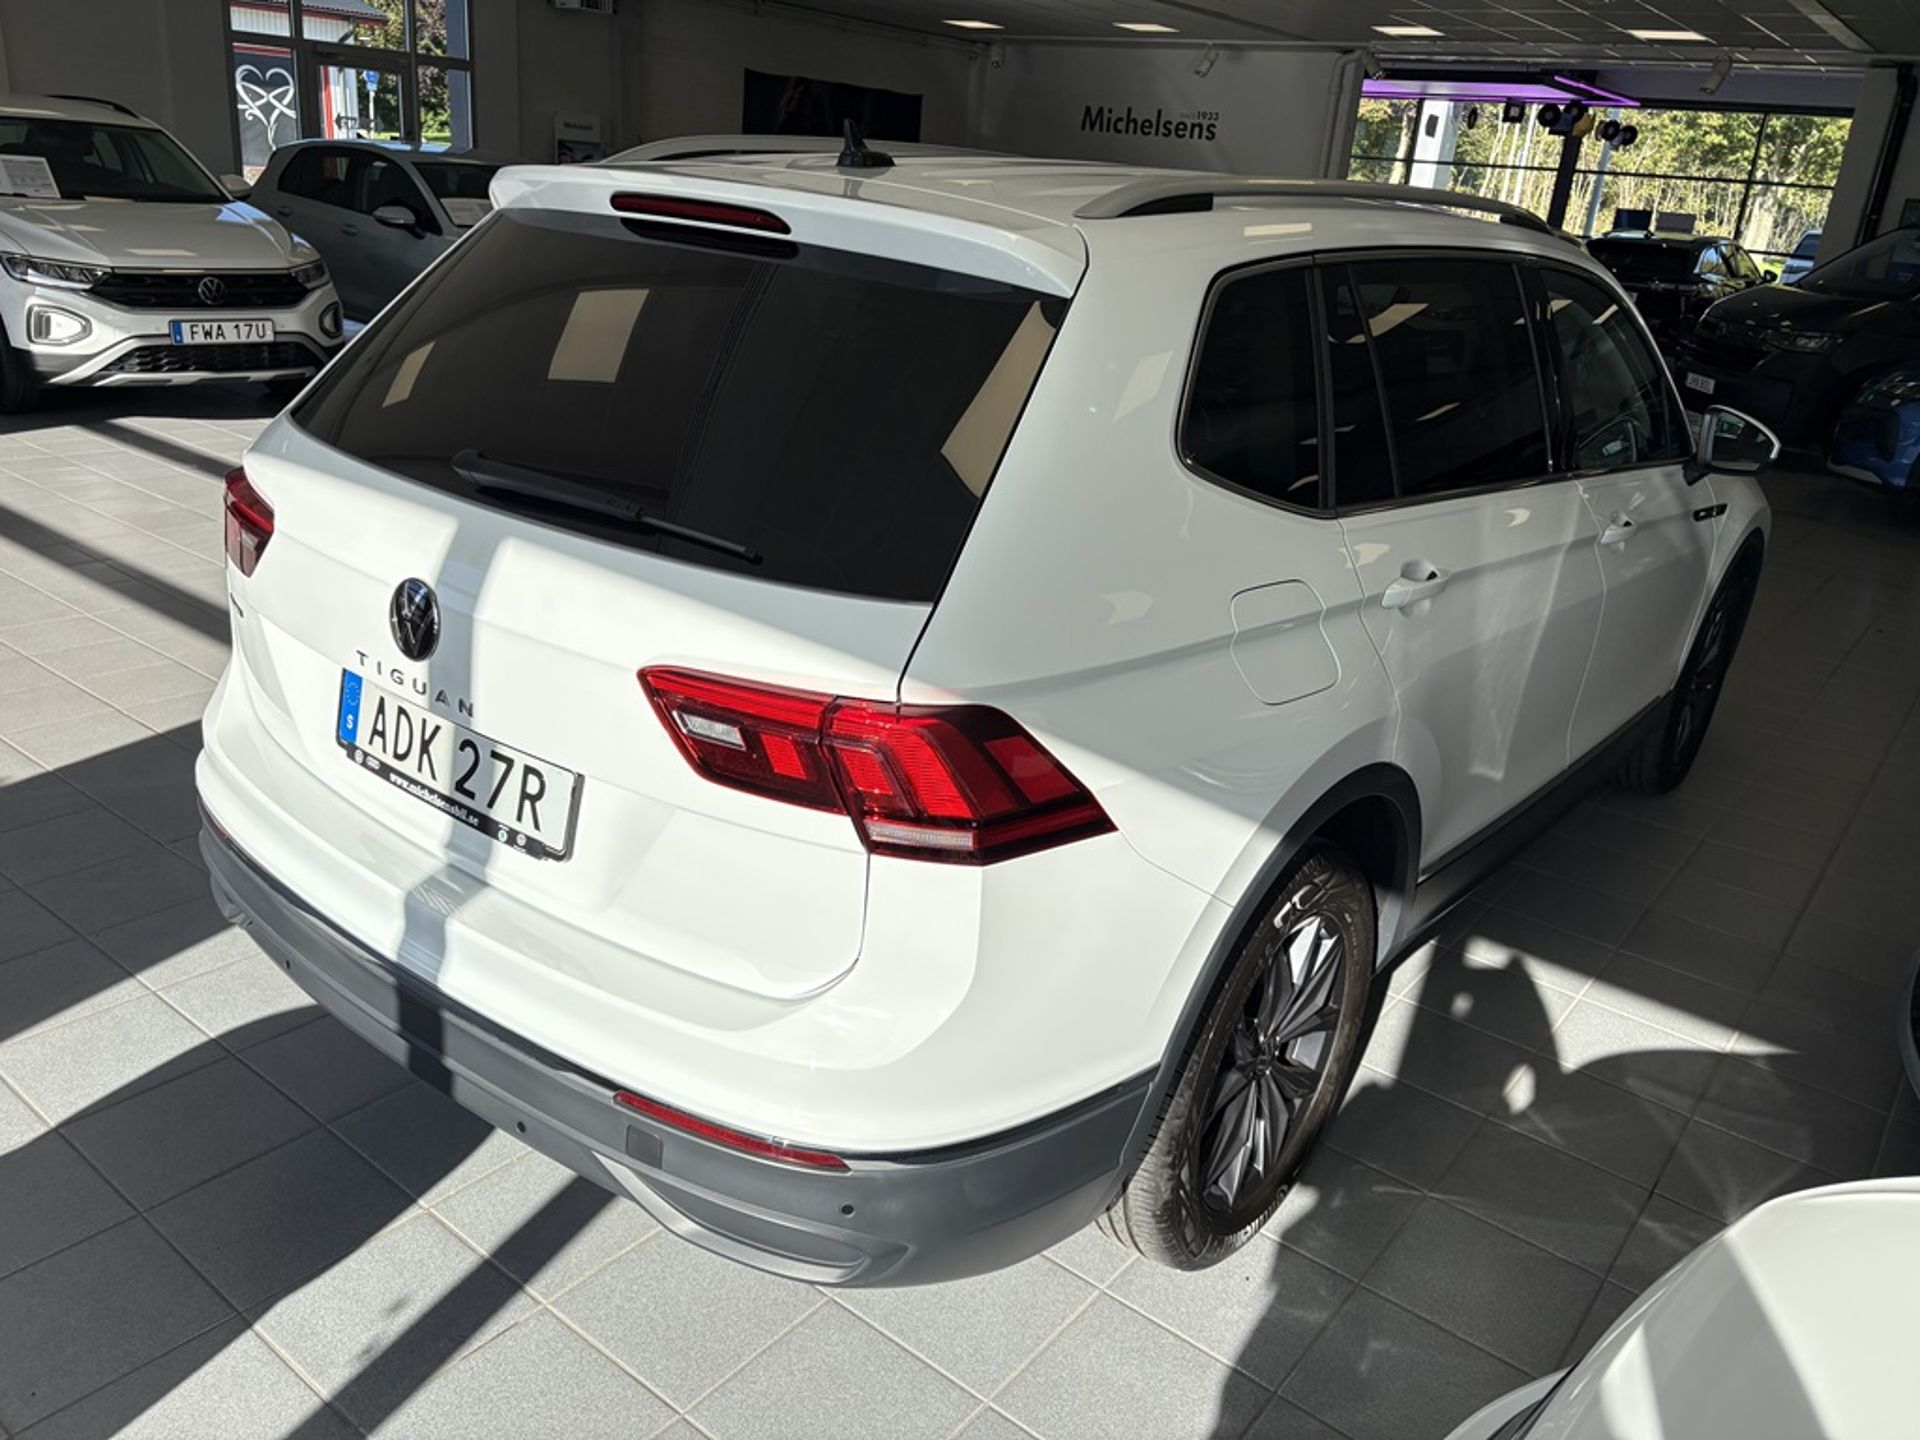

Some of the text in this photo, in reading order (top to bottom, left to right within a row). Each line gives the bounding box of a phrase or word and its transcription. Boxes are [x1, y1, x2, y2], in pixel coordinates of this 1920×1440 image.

[1080, 105, 1217, 141] Michelsens
[1197, 110, 1220, 121] 1933
[189, 323, 266, 340] FWA 17U
[355, 650, 474, 718] TIGUAN
[368, 695, 548, 832] ADK 27R
